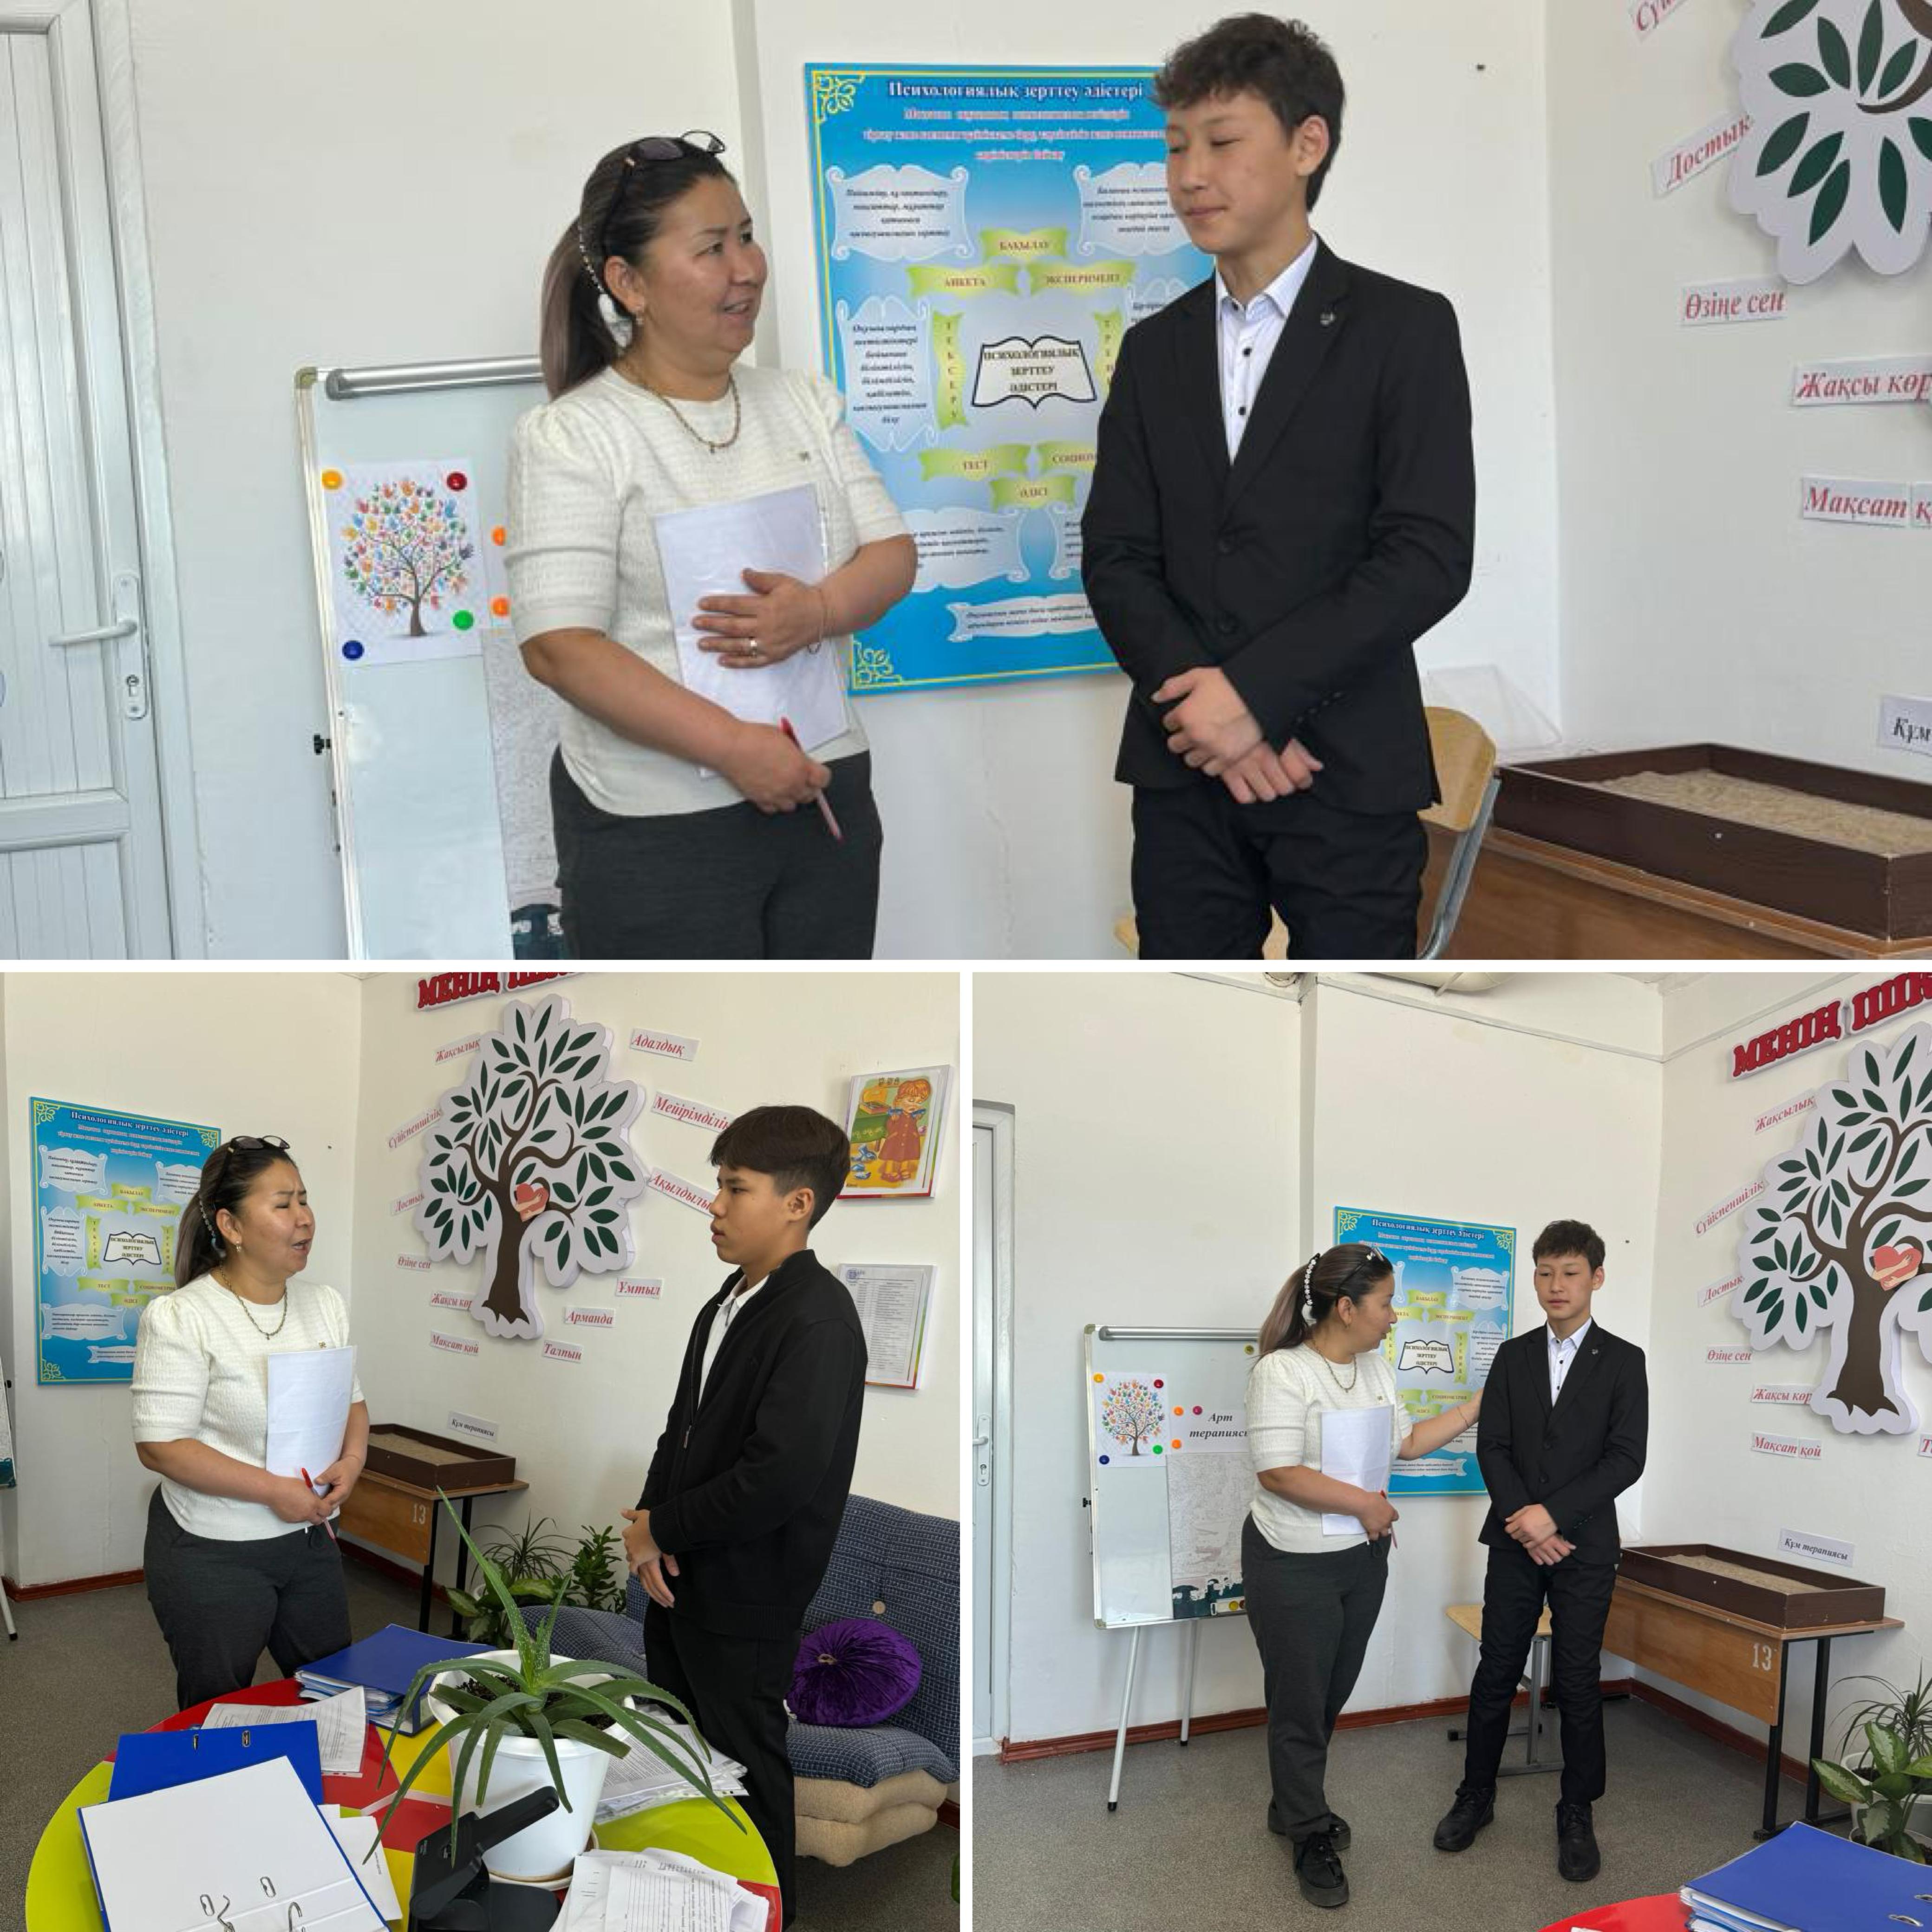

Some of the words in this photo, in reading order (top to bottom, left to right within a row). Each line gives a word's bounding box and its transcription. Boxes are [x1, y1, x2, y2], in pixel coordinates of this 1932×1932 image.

[1023, 84, 1078, 102] зерттеу
[944, 277, 986, 288] АНКЕТА
[1046, 273, 1120, 285] ЭКСПЕРИМЕНТ
[1797, 372, 1880, 400] Жақсы
[963, 459, 988, 471] ТЕСТ
[1803, 486, 1907, 521] Мақсат
[632, 1034, 685, 1057] Адалдық
[1733, 1000, 1841, 1077] МЕНІҢ
[567, 1311, 614, 1325] Арманда
[1708, 1349, 1732, 1363] Өзіңе
[1735, 1351, 1751, 1361] сен
[1753, 1389, 1789, 1402] Жақсы
[1208, 1412, 1233, 1424] Арт
[1755, 1436, 1797, 1455] Мақсат
[411, 1503, 426, 1525] 13
[1802, 1544, 1848, 1560] терапиясы
[1752, 1642, 1772, 1671] 13
